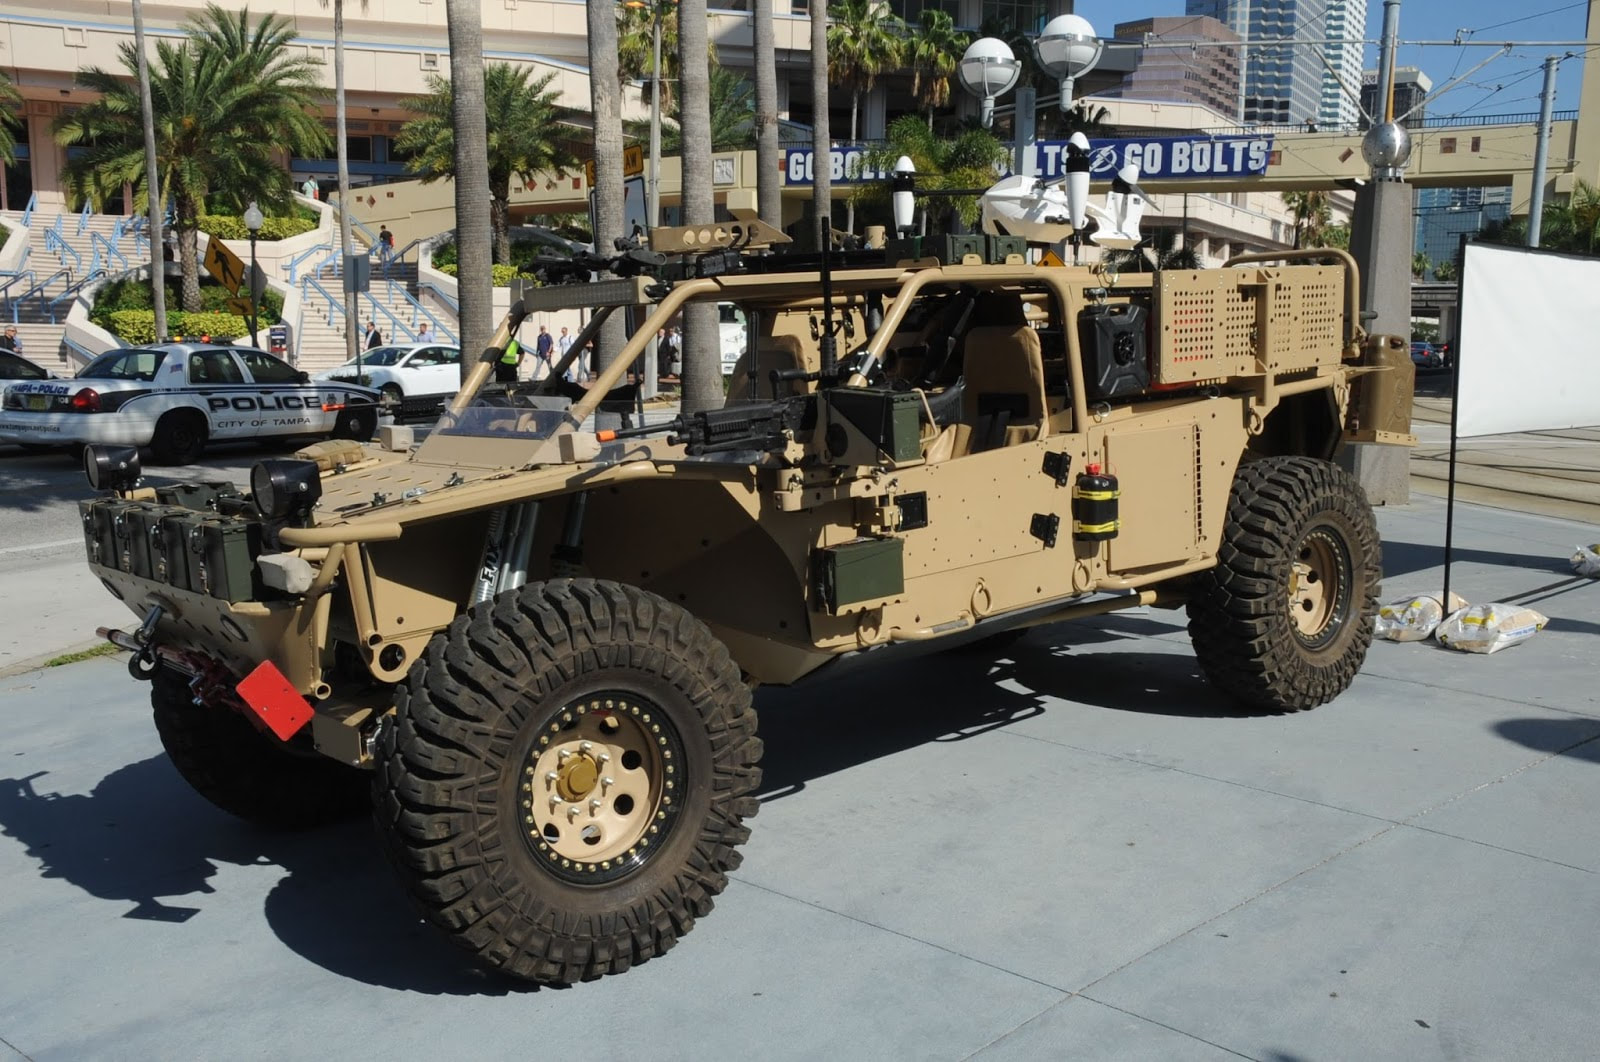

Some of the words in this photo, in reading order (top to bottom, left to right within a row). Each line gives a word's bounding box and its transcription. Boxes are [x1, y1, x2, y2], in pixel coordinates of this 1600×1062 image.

[1123, 143, 1163, 174] GO
[1171, 141, 1267, 173] BOLTS
[207, 397, 321, 413] POLICE
[217, 420, 246, 429] CITY
[250, 419, 269, 427] OF
[273, 417, 312, 427] TAMPA
